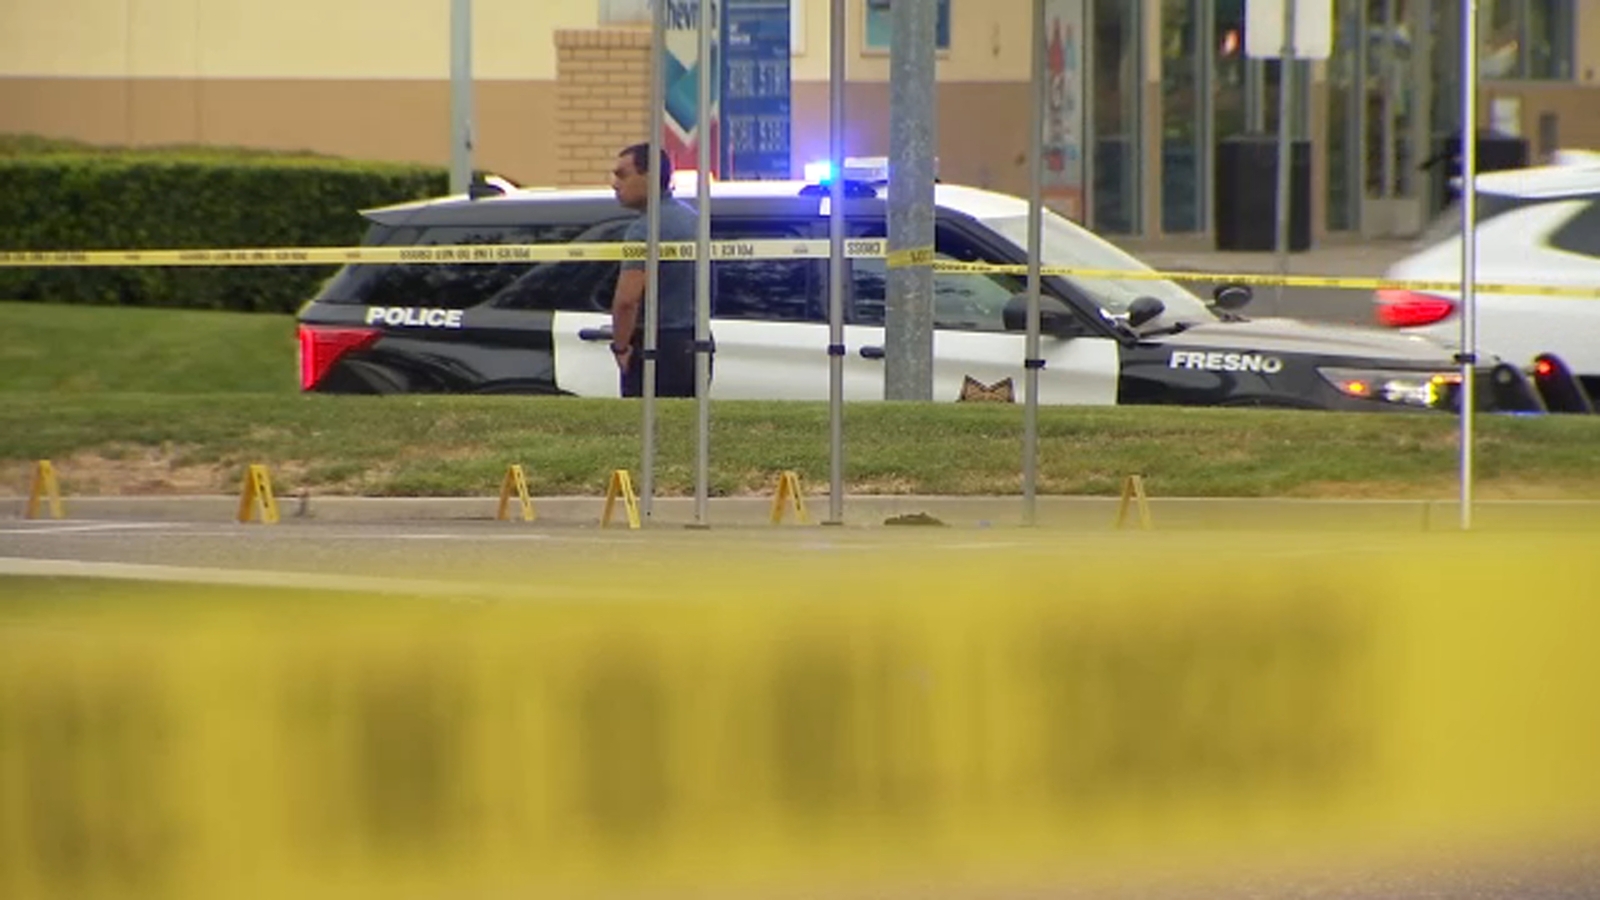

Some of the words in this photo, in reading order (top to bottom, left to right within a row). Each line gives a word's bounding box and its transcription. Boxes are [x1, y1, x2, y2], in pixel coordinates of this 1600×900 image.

[721, 244, 754, 256] POLICE
[846, 242, 881, 255] CROSS
[365, 305, 464, 328] POLICE
[1169, 350, 1283, 374] FRESNO
